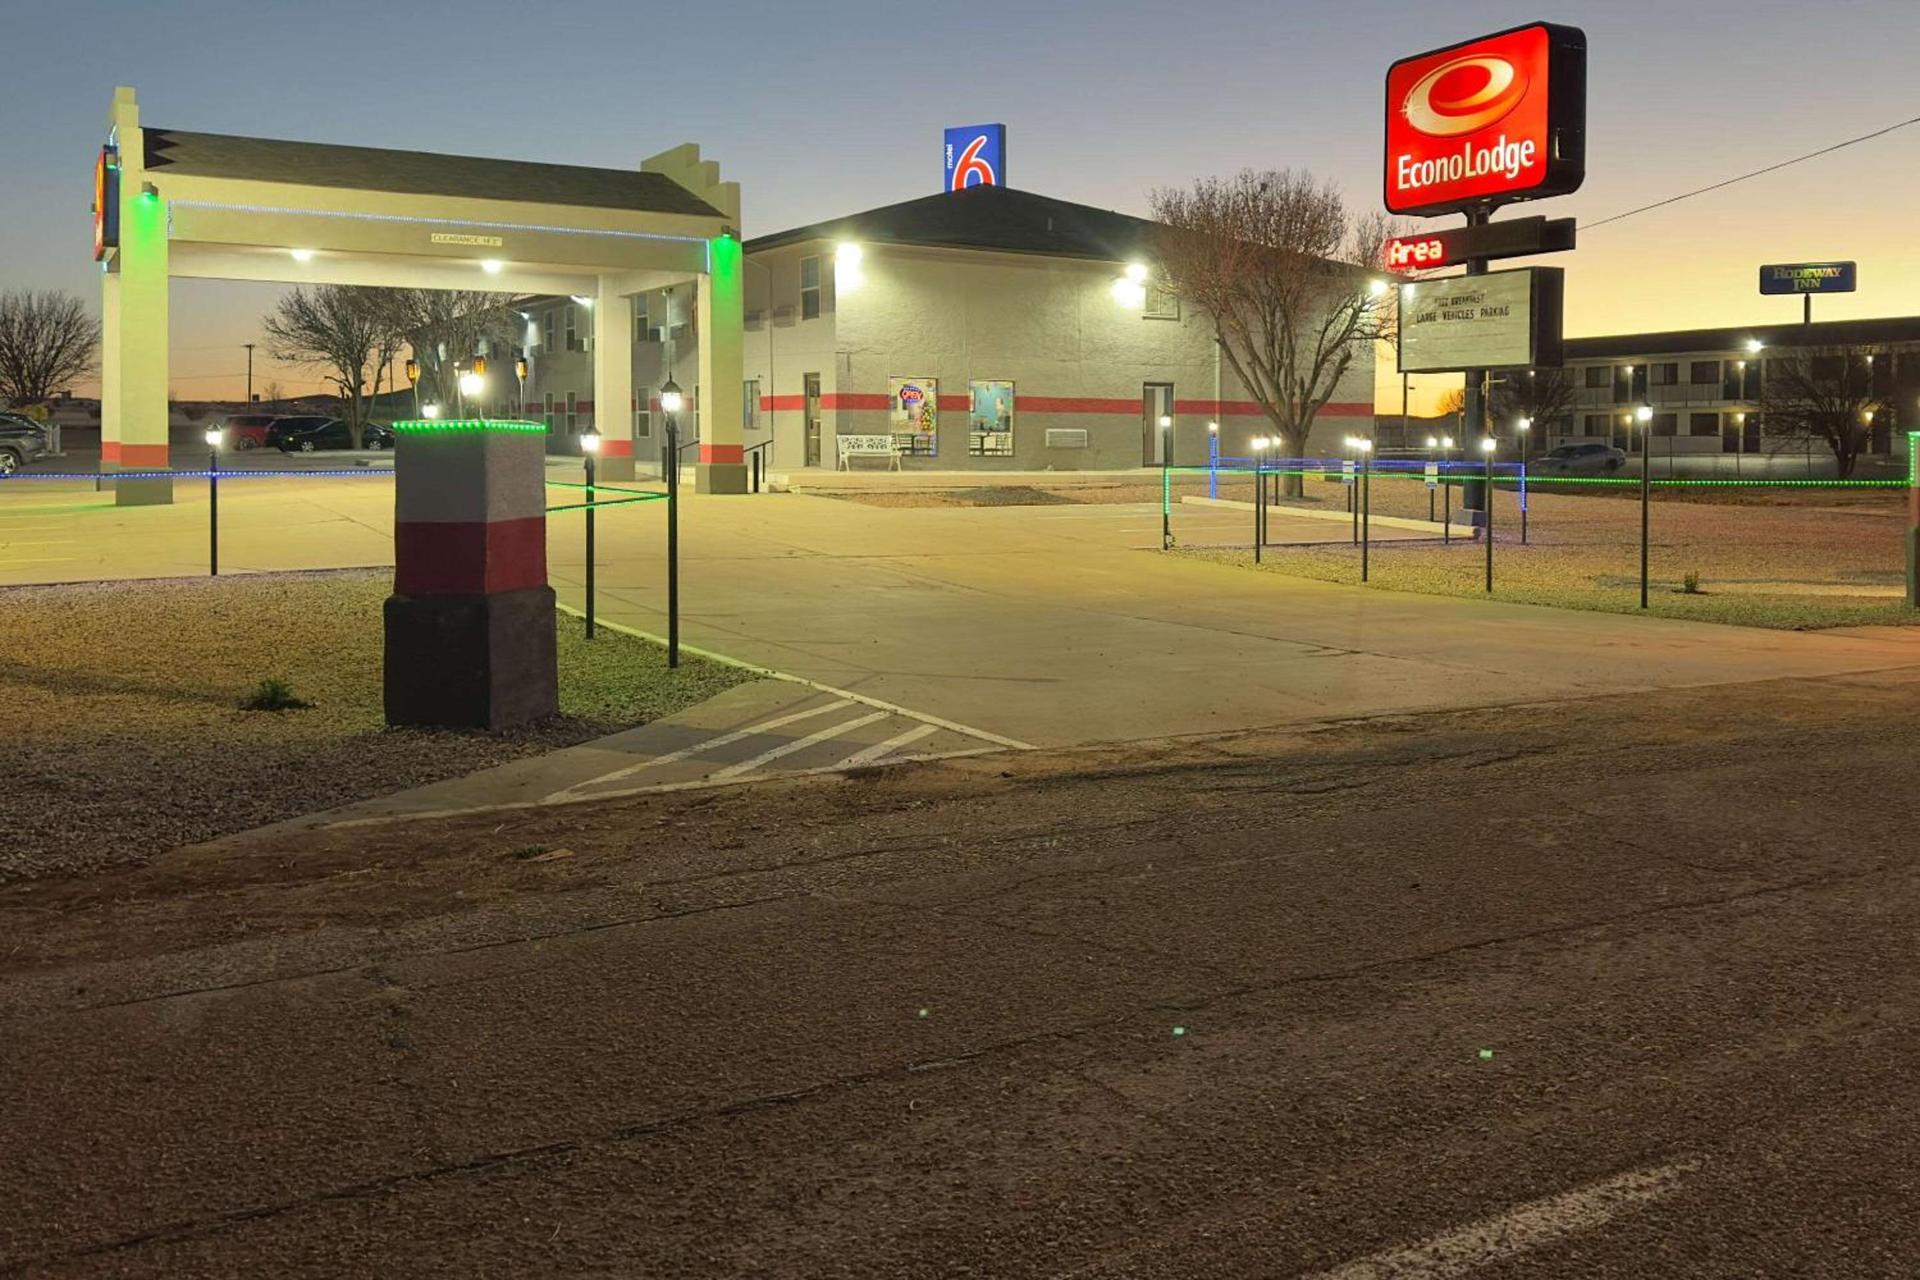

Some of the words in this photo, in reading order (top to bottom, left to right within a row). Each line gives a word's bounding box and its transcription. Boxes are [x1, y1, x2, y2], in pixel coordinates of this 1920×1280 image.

[952, 135, 996, 191] 6
[1398, 134, 1535, 190] EconoLodge
[1390, 239, 1443, 265] Area
[1772, 267, 1843, 280] RODEWAY
[1793, 278, 1822, 292] INN
[1416, 311, 1437, 323] LARGE
[1442, 309, 1474, 320] VEHICLES
[1480, 305, 1510, 318] PARKING
[902, 390, 923, 400] OPEN
